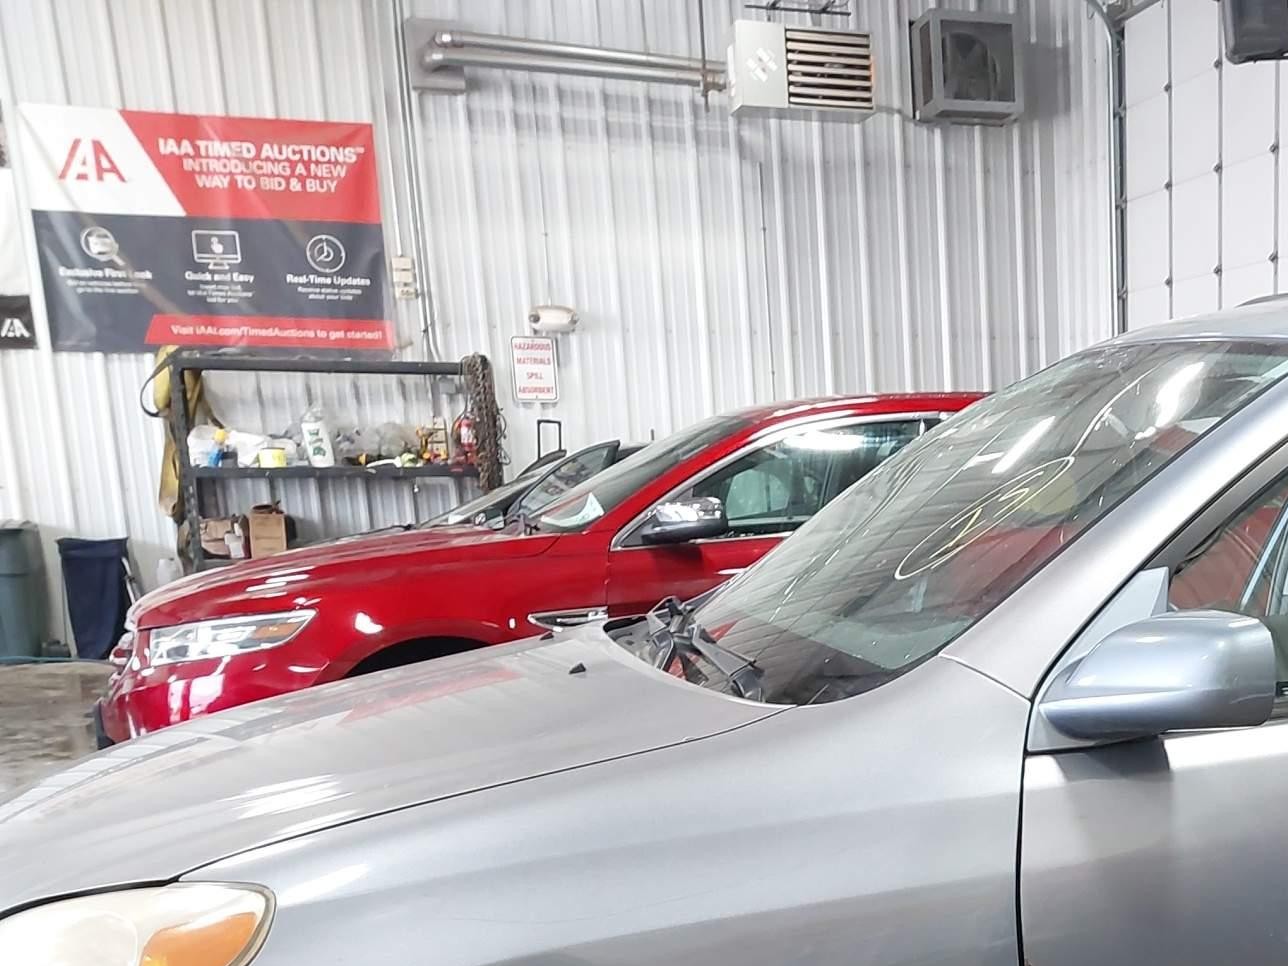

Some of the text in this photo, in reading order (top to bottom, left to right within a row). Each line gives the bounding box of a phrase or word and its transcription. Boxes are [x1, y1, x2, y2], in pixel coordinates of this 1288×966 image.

[158, 137, 195, 156] IAA
[195, 140, 256, 159] TIMED
[182, 158, 346, 178] INTRODUCING A NEW
[194, 174, 338, 193] WAY TO BID & BUY
[233, 272, 255, 284] Easy
[286, 274, 371, 287] Real-Time Updates
[316, 330, 327, 338] to
[329, 331, 345, 341] get
[516, 356, 551, 365] MATERIALS
